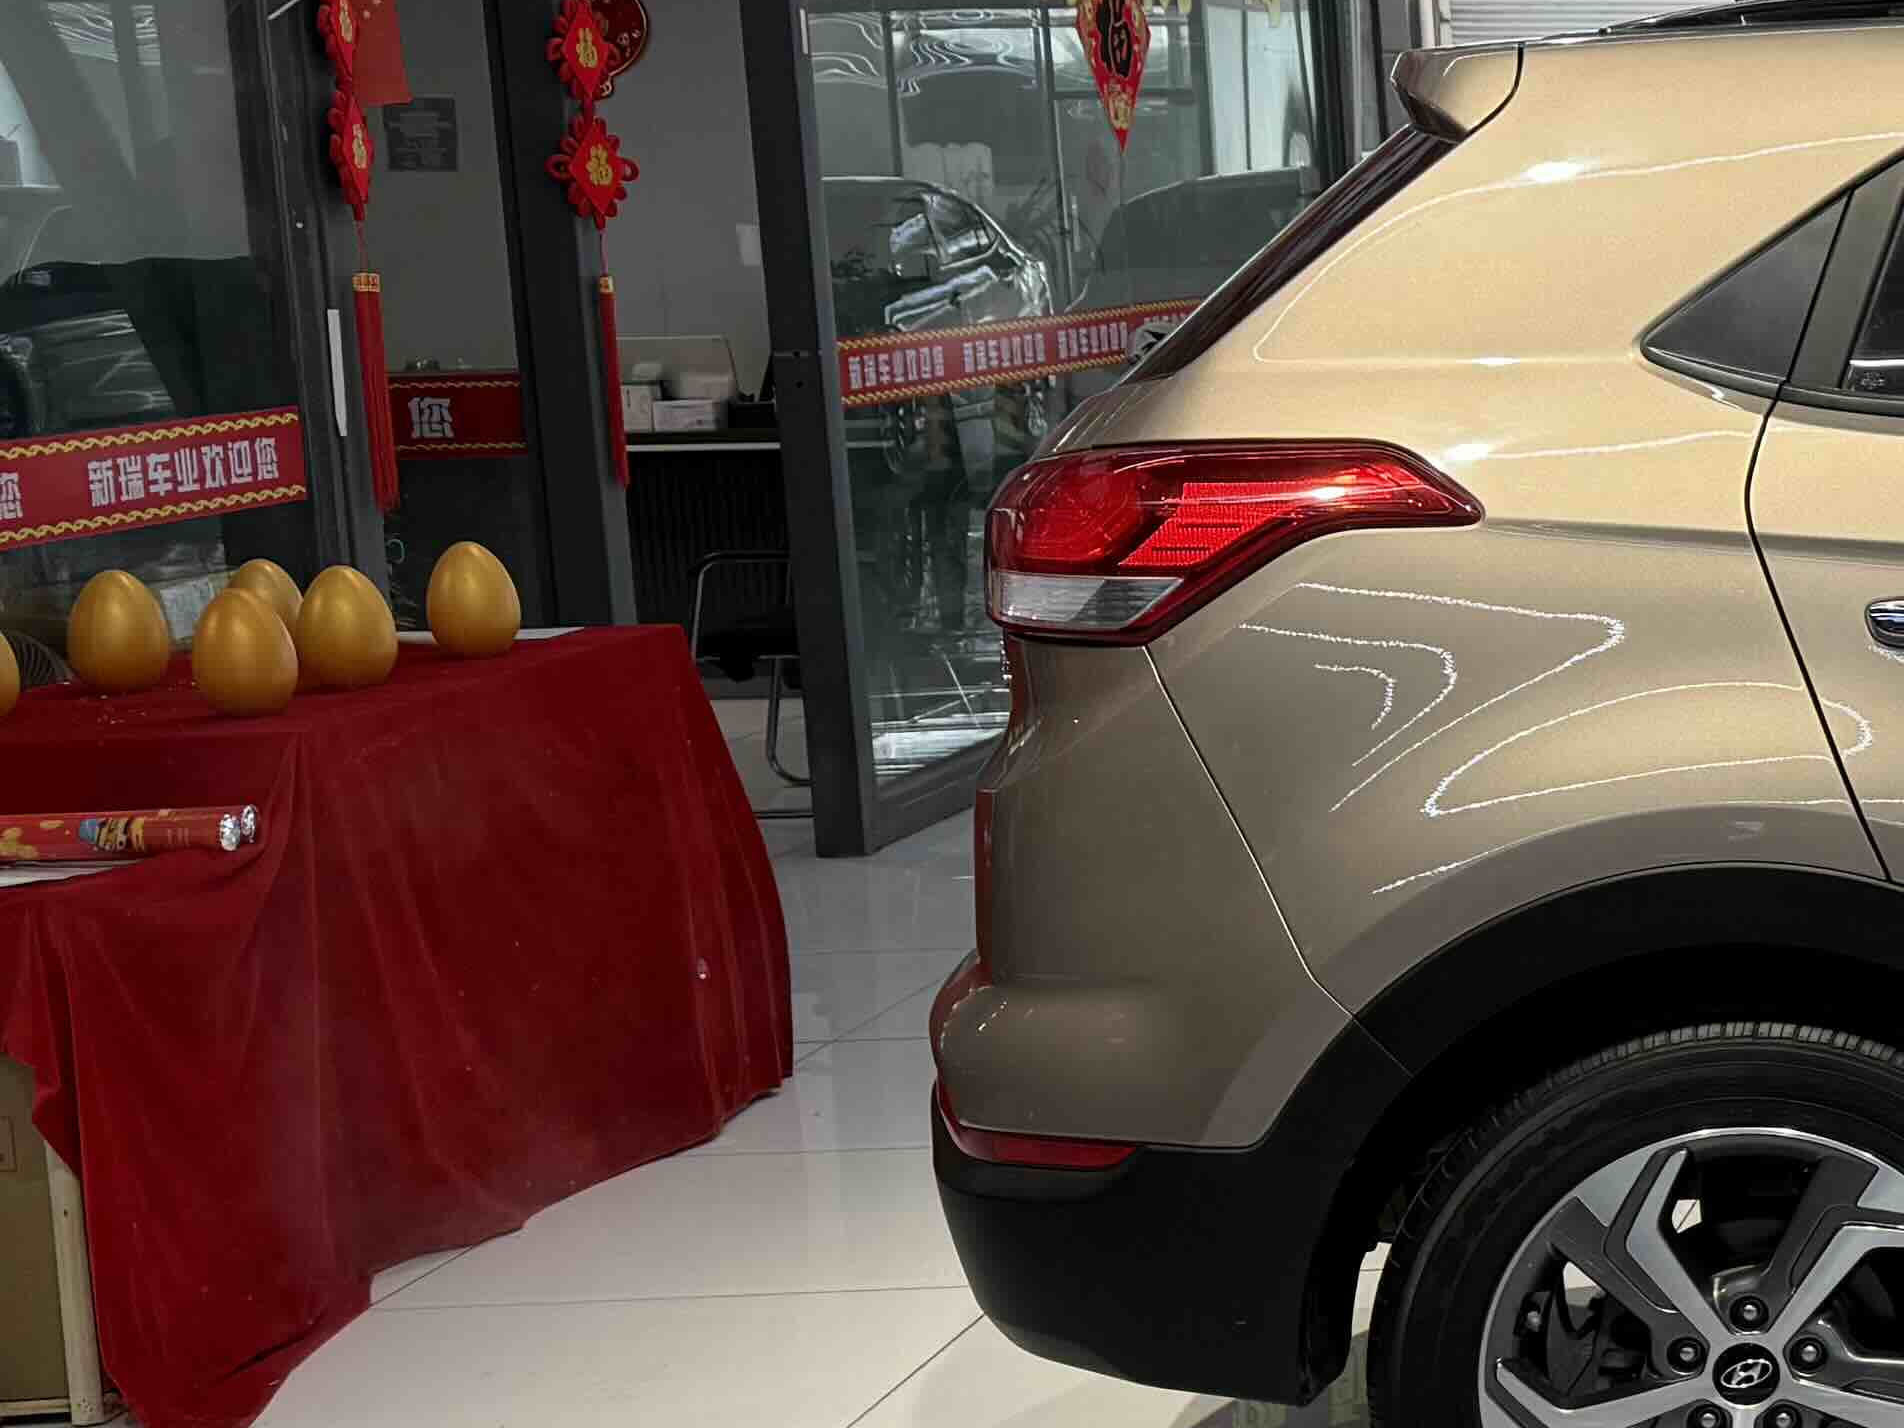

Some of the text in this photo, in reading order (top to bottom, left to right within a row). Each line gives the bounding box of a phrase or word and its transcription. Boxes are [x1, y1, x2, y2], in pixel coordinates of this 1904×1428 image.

[408, 396, 457, 440] 您
[87, 437, 281, 509] 新瑞车业欢迎您
